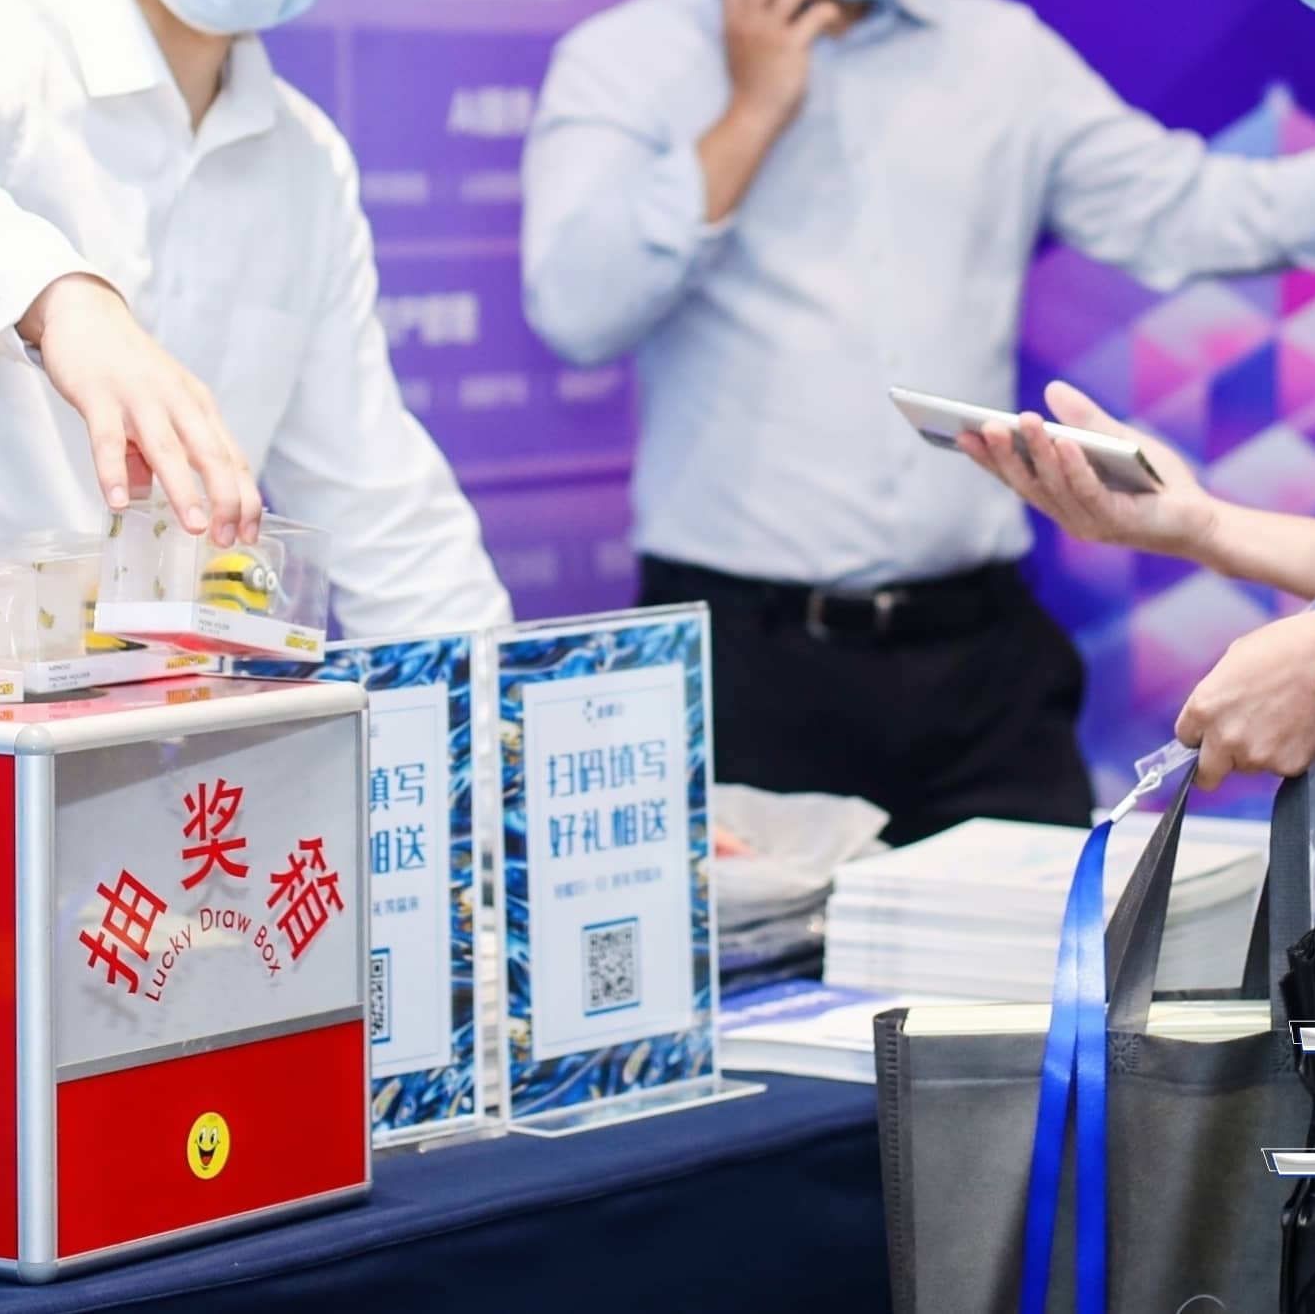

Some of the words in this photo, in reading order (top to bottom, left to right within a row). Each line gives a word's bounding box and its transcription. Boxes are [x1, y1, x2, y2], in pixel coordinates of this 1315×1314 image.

[546, 738, 668, 799] 扫码填写
[548, 797, 669, 859] 好礼相送
[78, 777, 347, 996] 抽奖箱
[144, 923, 193, 1003] Lucky
[198, 906, 252, 935] Draw
[253, 924, 282, 978] Box
